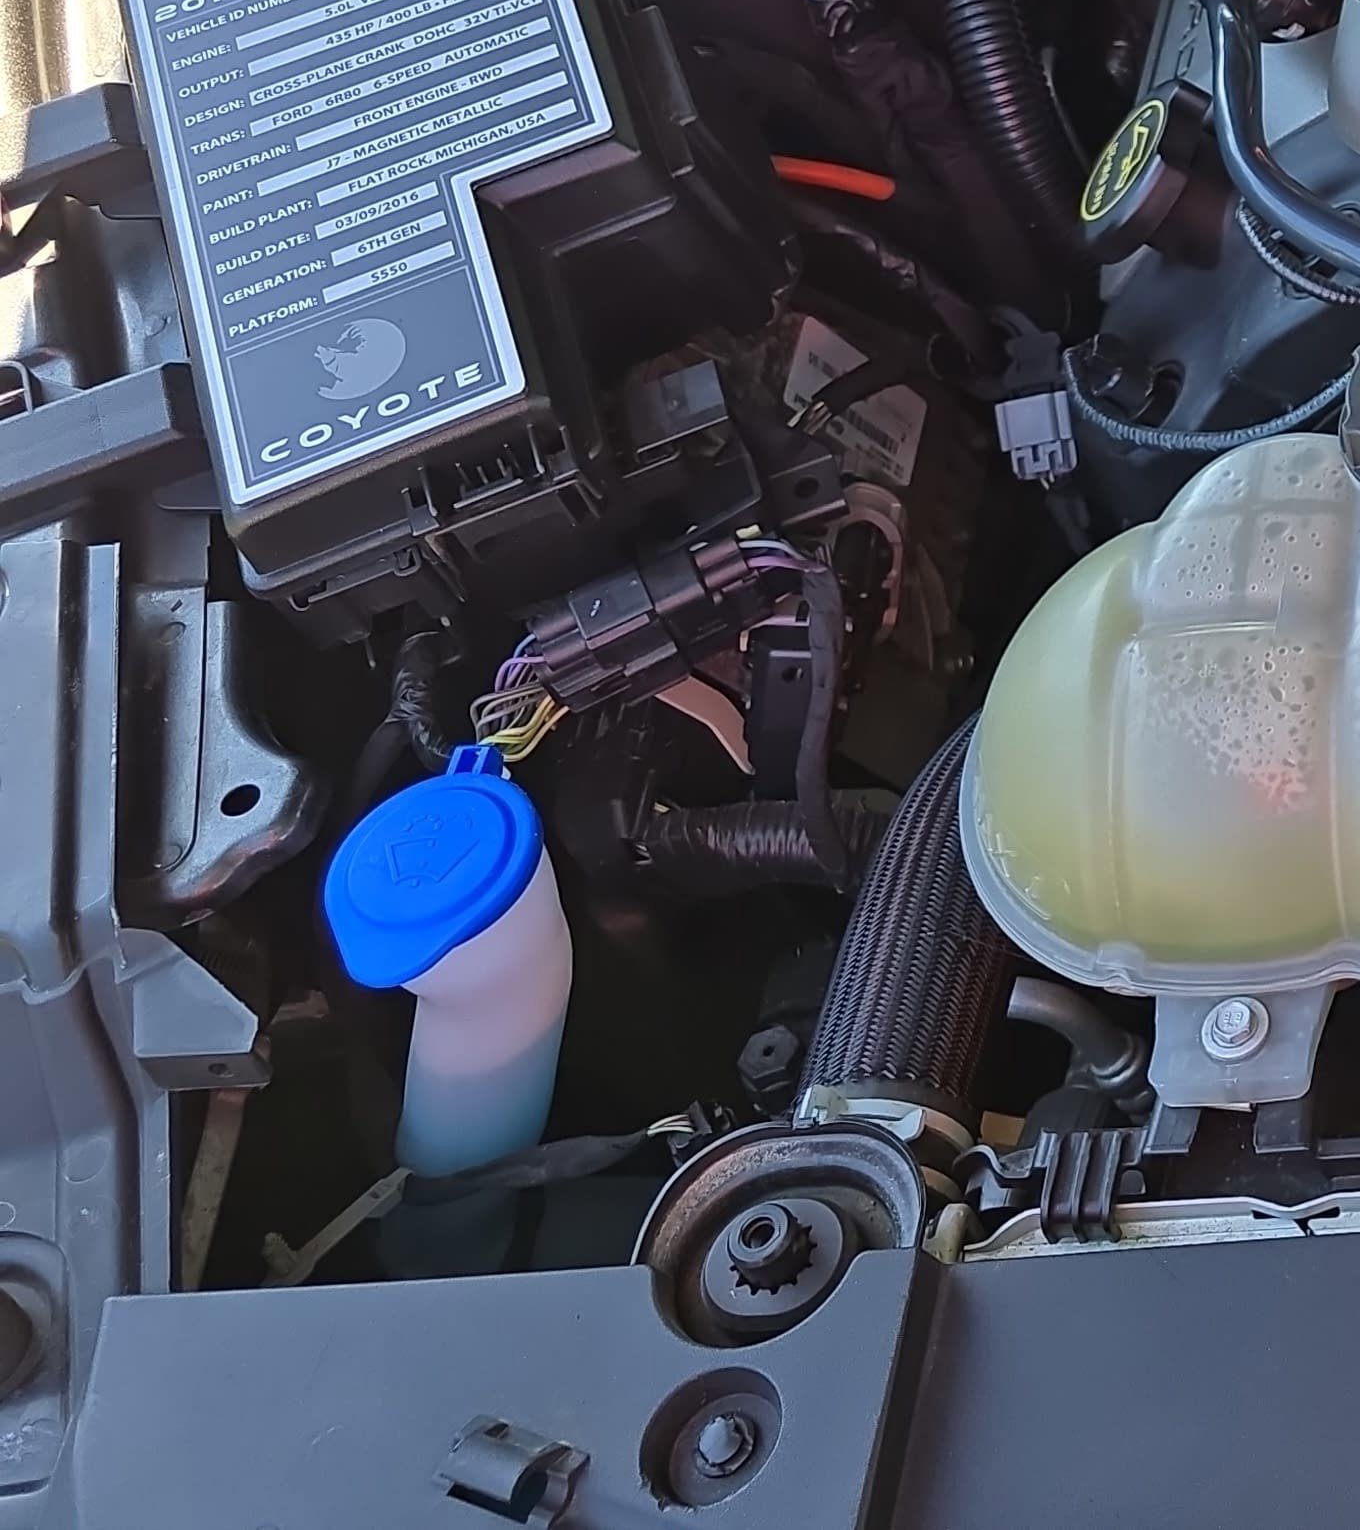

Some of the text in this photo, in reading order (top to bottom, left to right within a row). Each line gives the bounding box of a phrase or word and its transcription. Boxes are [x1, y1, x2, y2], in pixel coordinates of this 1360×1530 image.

[166, 15, 227, 43] VEHICLE
[229, 9, 245, 22] ID
[172, 44, 232, 71] ENGINE:
[324, 1, 354, 18] 5.0L
[178, 68, 245, 98] OUTPUT:
[325, 30, 352, 46] 435
[355, 22, 375, 36] HP
[385, 9, 412, 24] 400
[414, 1, 433, 14] LB
[184, 98, 246, 127] DESIGN:
[253, 61, 354, 101] CROSS-PLANE
[355, 42, 405, 66] CRANK
[413, 22, 456, 45] DOHC
[464, 10, 491, 27] 32V
[190, 26, 529, 155] TRANS: FORD 6R80 6-SPEED AUTOMATIC
[196, 144, 292, 185] DRIVETRAIN:
[354, 102, 402, 127] FRONT
[405, 84, 460, 109] ENGINE
[470, 66, 503, 86] RWD
[202, 188, 253, 214] PAINT:
[325, 156, 342, 170] J7
[353, 121, 431, 159] MAGNETIC
[432, 96, 504, 130] METALLIC
[209, 113, 546, 244] BUILD PLANT: FLAT ROCK, MICHIGAN, USA
[215, 192, 419, 275] BUILD DATE: 03/09/2016
[222, 223, 422, 306] GENERATION: 6TH GEN
[228, 261, 408, 337] PLATFORM: S550
[260, 361, 484, 463] COYOTE
